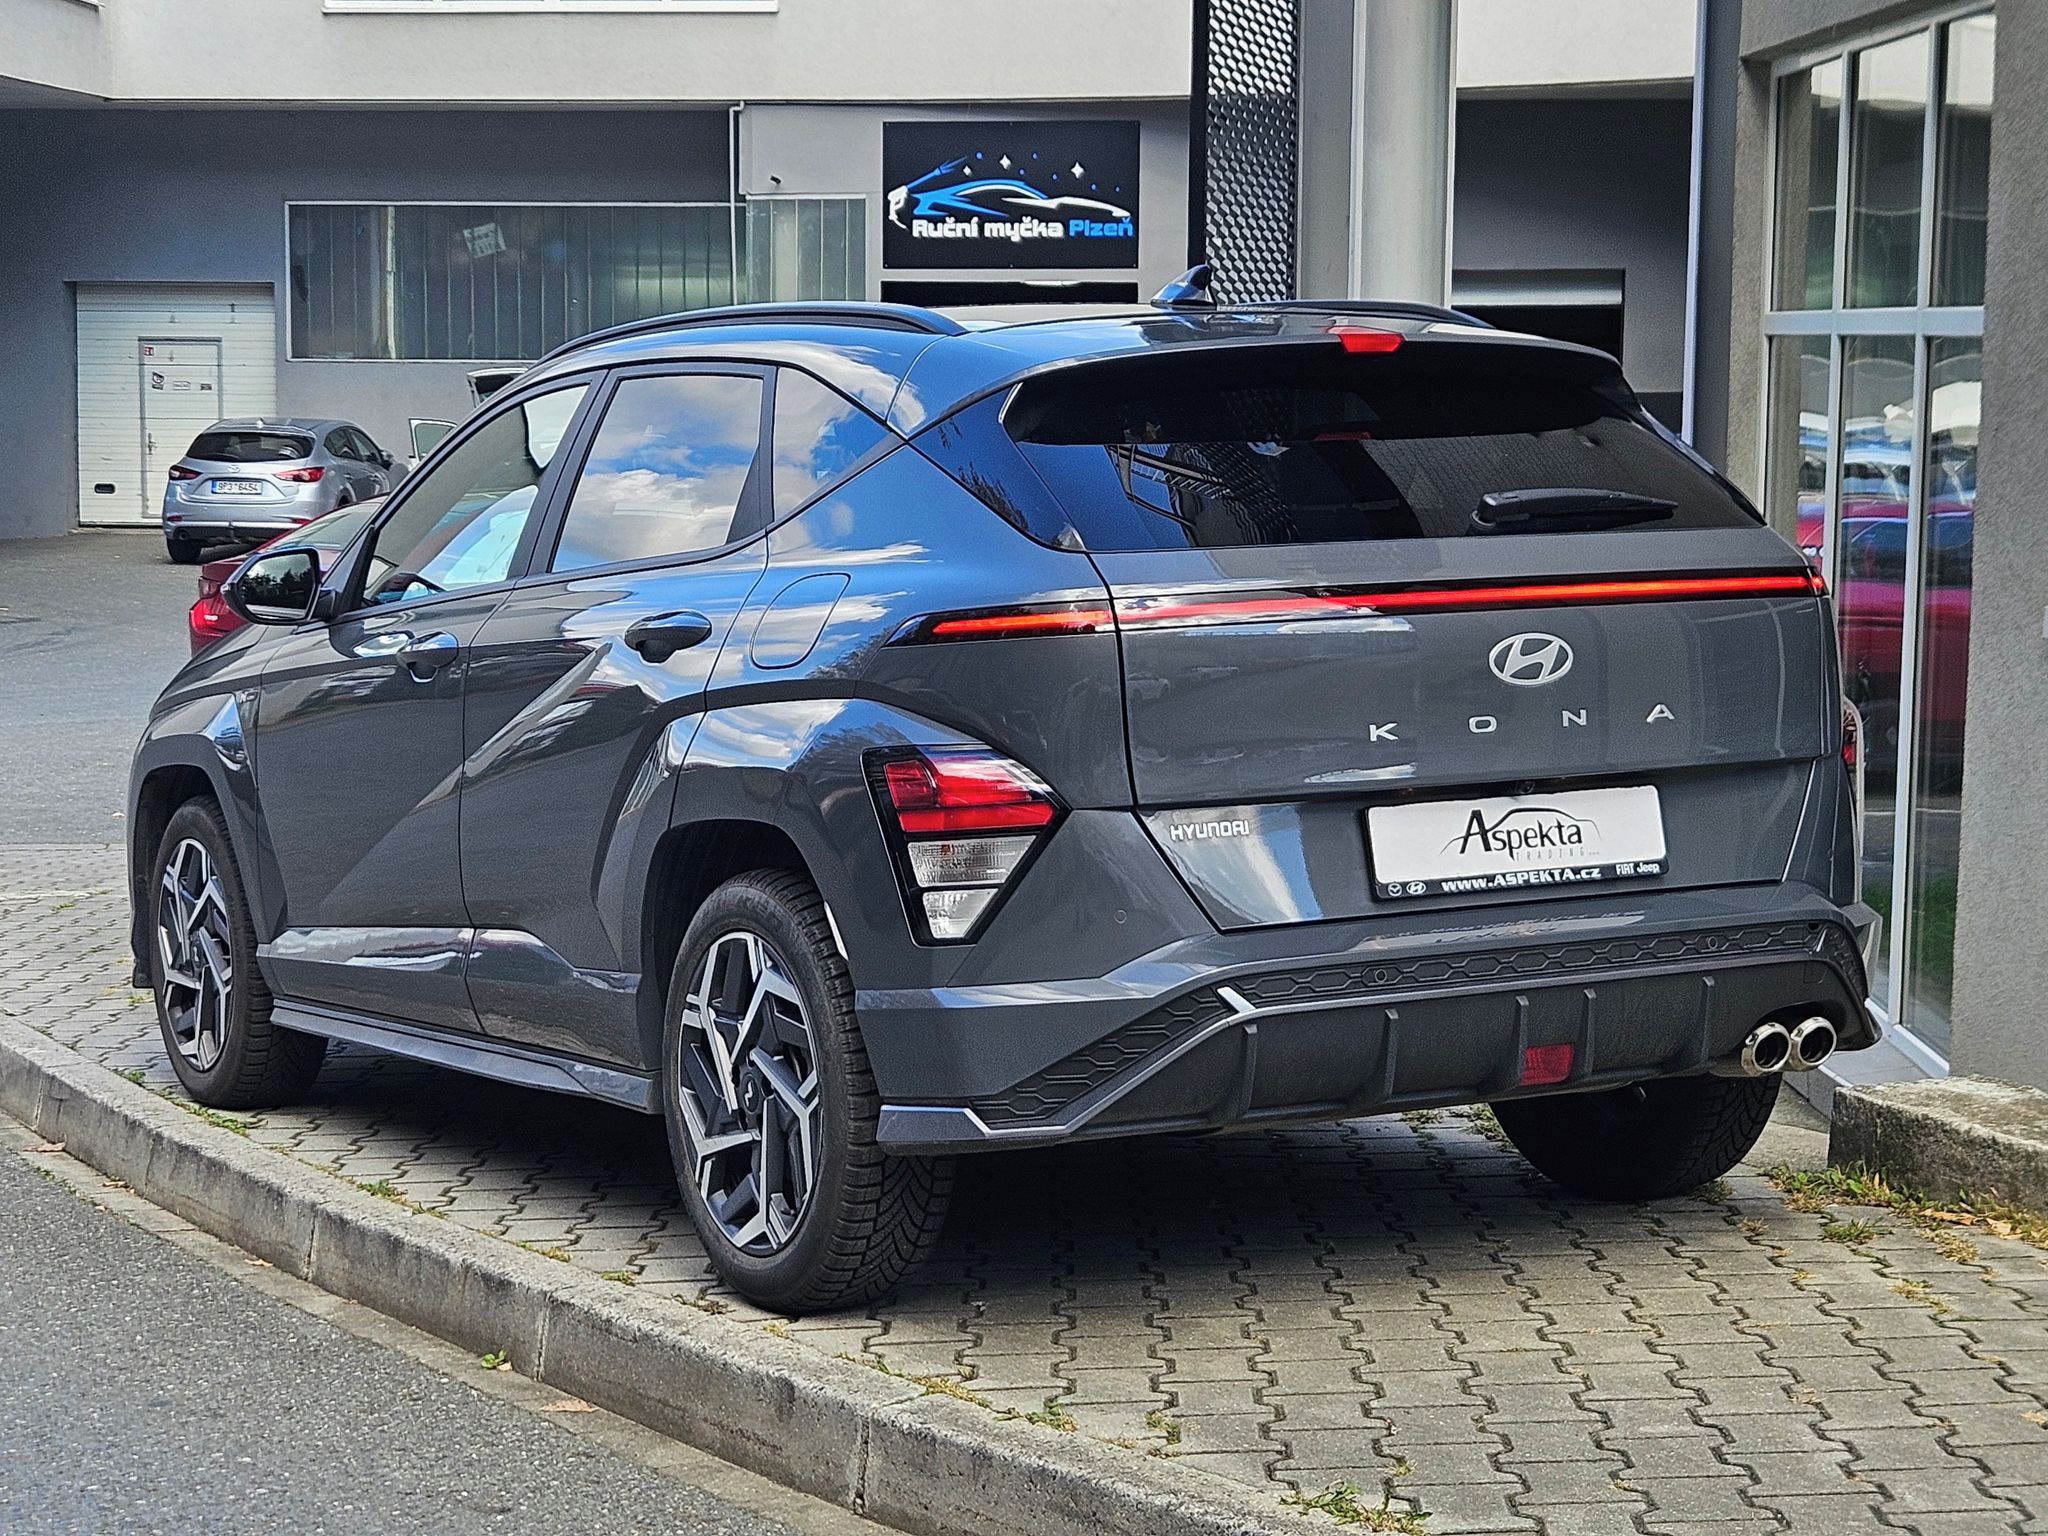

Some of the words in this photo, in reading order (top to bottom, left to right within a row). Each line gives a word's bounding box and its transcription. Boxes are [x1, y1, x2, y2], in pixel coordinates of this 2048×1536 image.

[911, 216, 978, 238] Ruční
[984, 216, 1064, 242] myčka
[1069, 217, 1133, 237] Plzeň
[1368, 703, 1676, 742] KONA
[1169, 819, 1250, 841] HYUNDAI
[1459, 809, 1583, 861] Aspekta
[1441, 868, 1602, 893] www.ASPEKTA.cz
[1616, 864, 1635, 876] FIAT
[1637, 862, 1661, 874] Jeep
